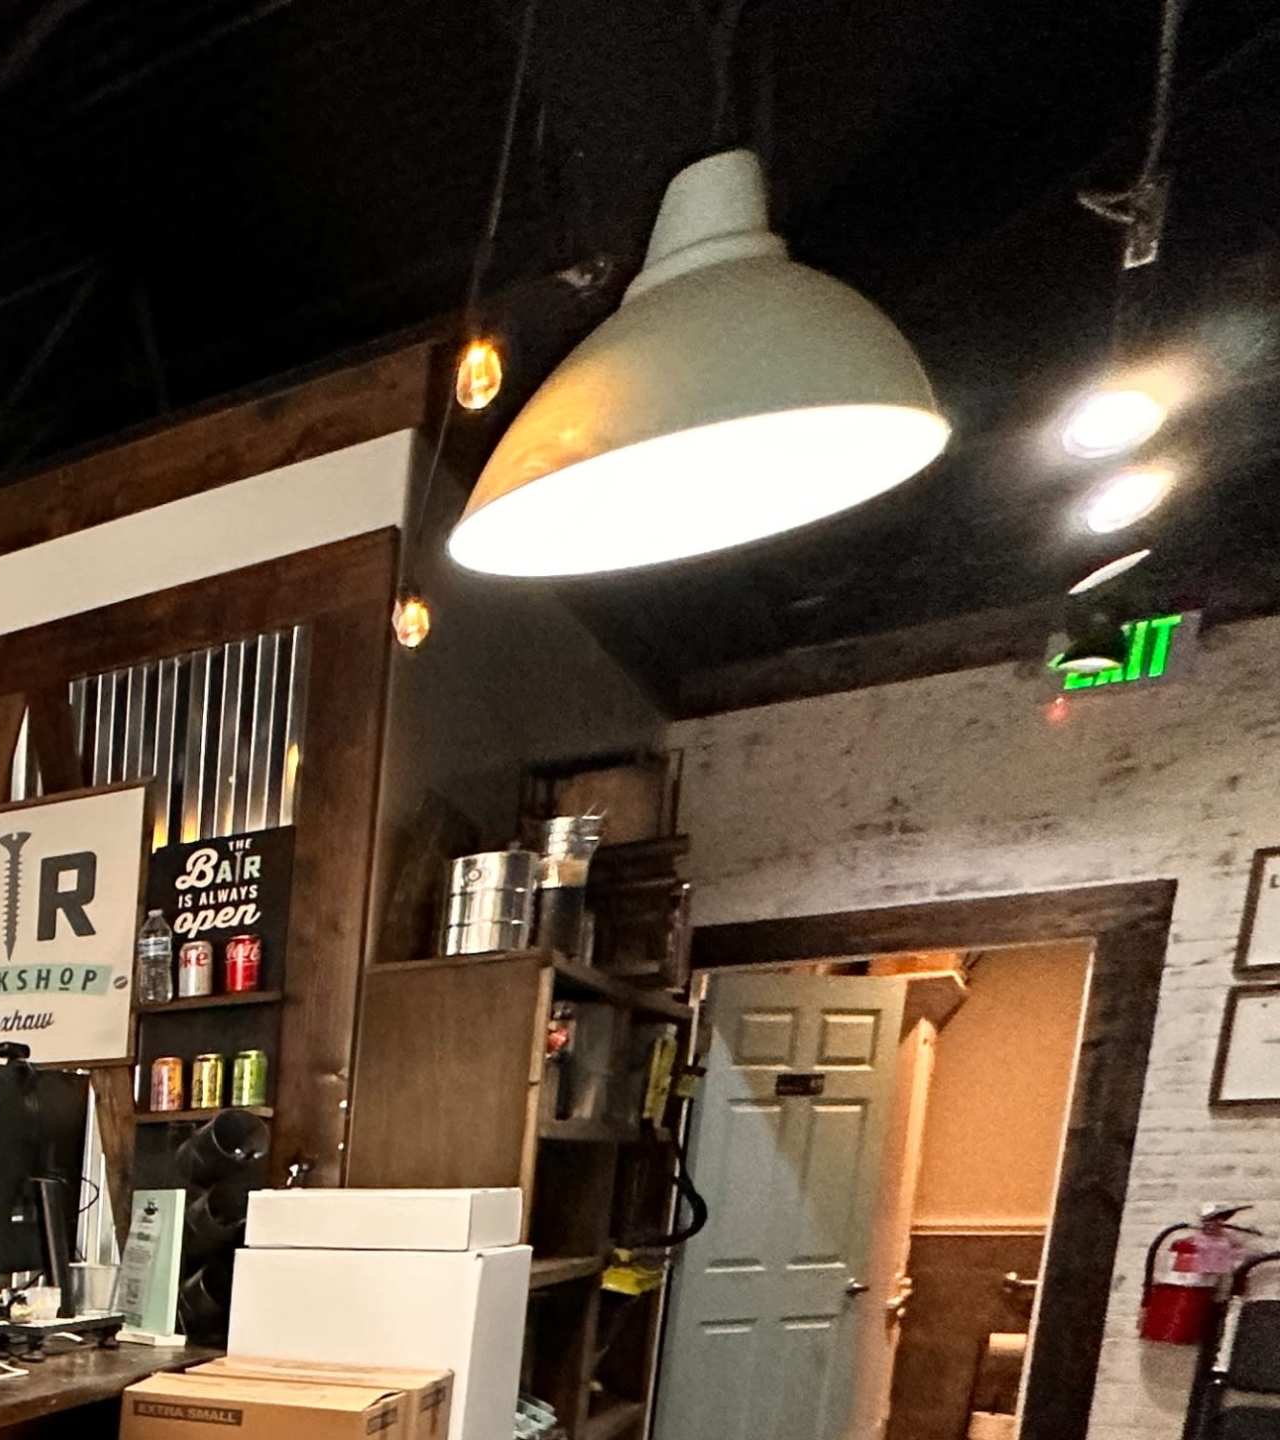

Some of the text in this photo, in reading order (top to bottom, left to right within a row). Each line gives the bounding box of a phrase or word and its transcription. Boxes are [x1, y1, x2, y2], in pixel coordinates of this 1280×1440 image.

[228, 837, 253, 852] THE
[178, 884, 258, 908] IS ALWAYS
[174, 902, 261, 938] open
[138, 1404, 237, 1422] EXTRA SMALL
